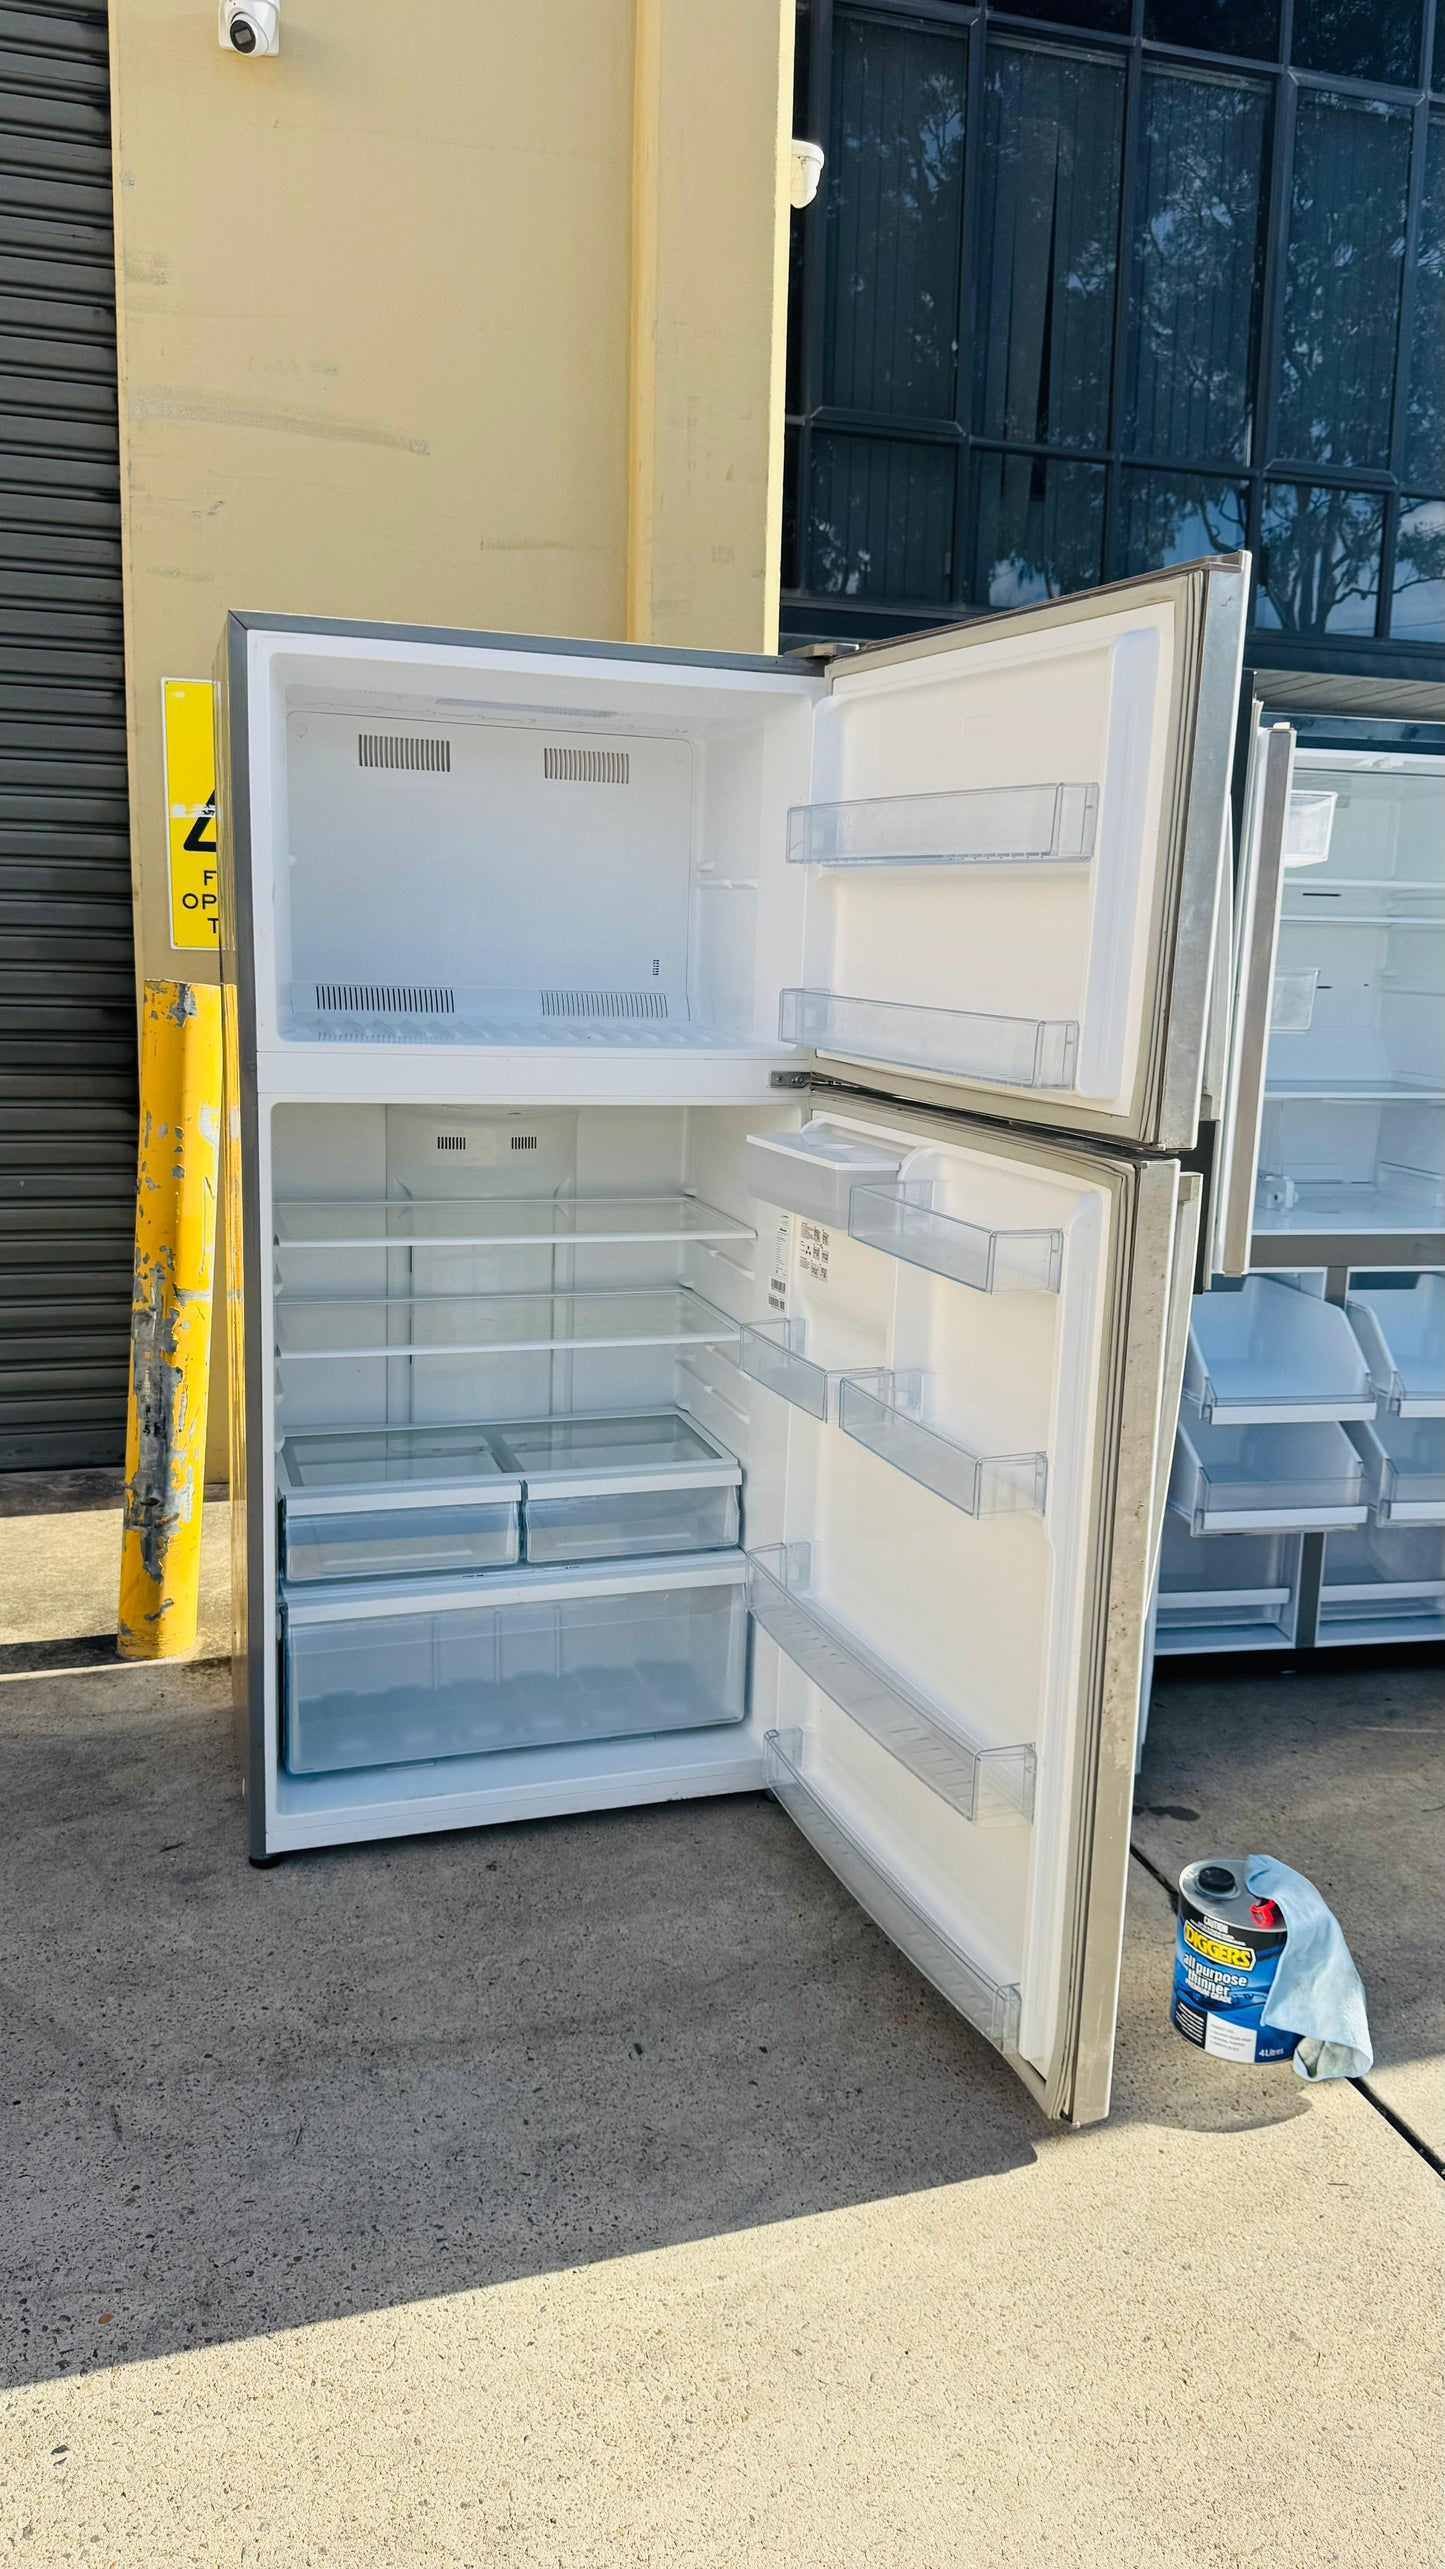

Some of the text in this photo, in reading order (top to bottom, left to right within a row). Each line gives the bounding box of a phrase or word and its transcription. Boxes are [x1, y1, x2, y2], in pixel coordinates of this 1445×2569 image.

[1185, 1924, 1251, 1969] DIGGERS
[1184, 1954, 1248, 1987] all purpose
[1188, 1969, 1230, 1995] thinner
